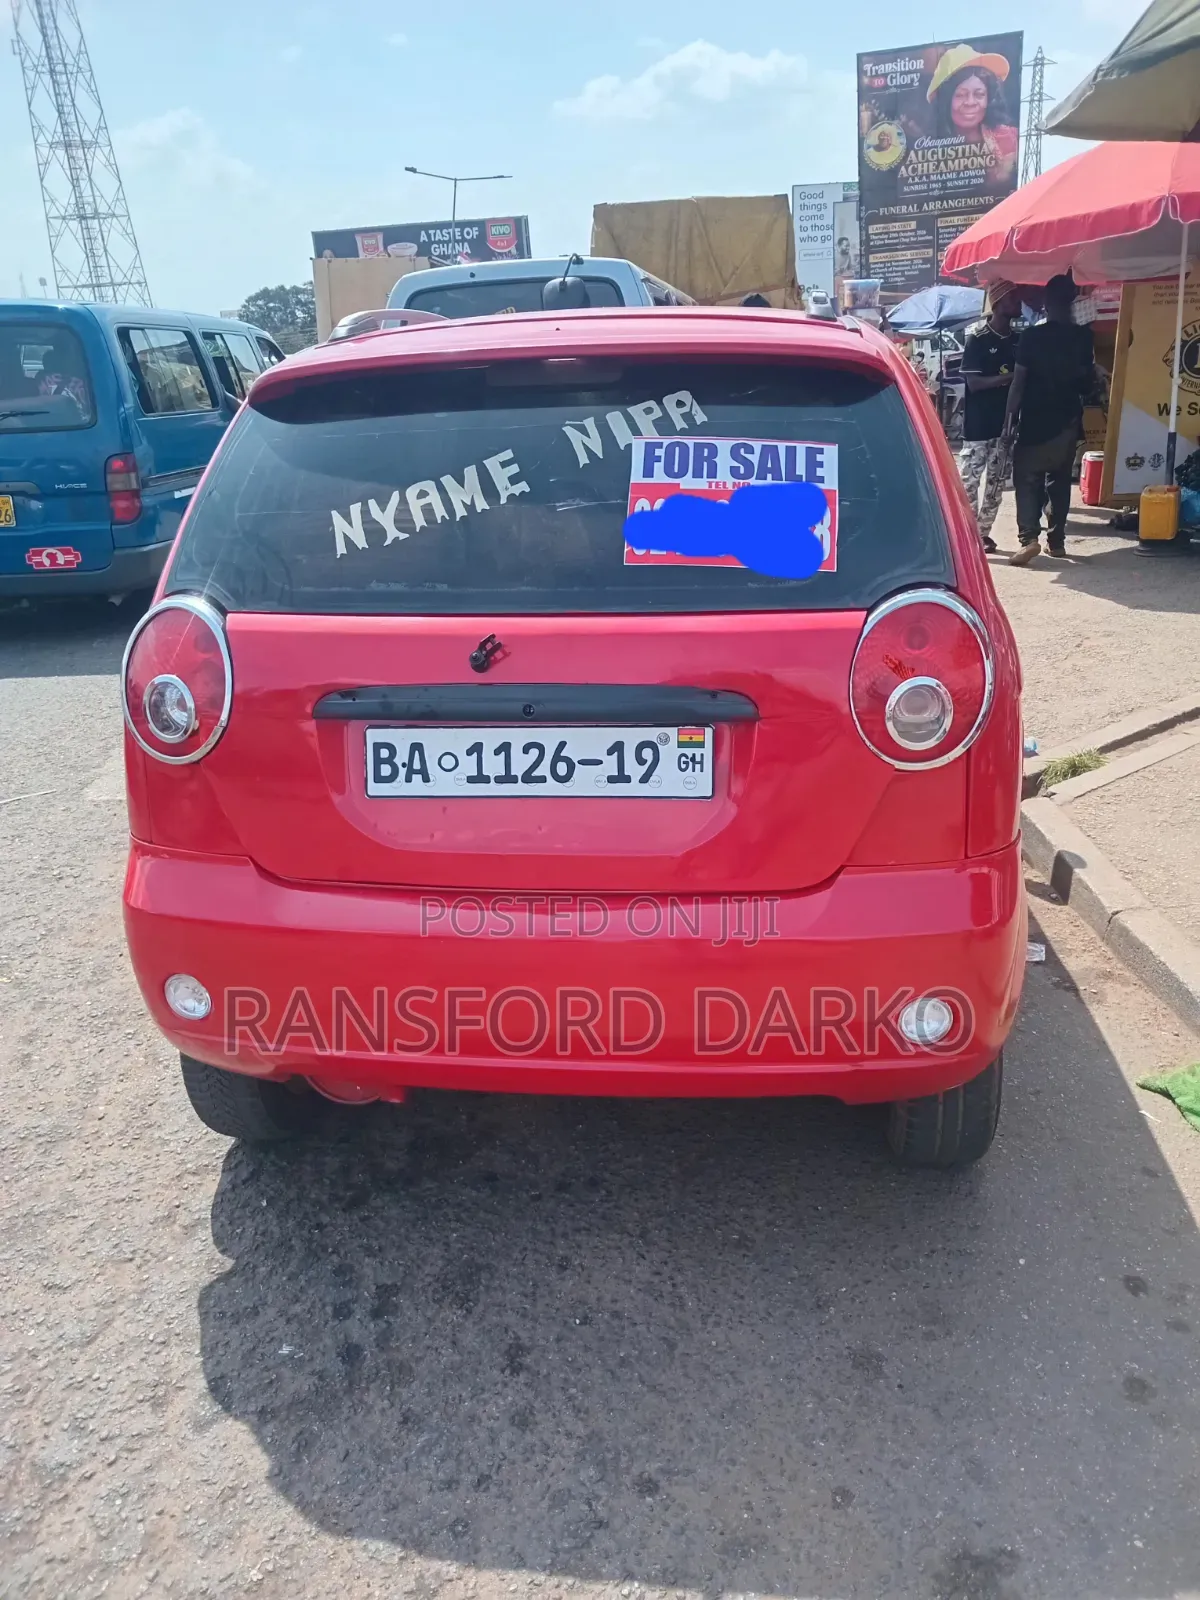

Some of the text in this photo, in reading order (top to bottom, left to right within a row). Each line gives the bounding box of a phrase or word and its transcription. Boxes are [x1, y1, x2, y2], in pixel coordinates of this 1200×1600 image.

[863, 57, 925, 77] Transition
[886, 72, 921, 87] Glory
[905, 143, 990, 165] AUGUSTINA
[897, 154, 996, 179] ACHEAMPONG
[930, 171, 958, 182] MAAME
[958, 168, 986, 178] ADWOA
[903, 182, 929, 192] SUNRISE
[946, 179, 969, 188] SUNSET
[970, 176, 985, 185] 2026
[799, 190, 824, 201] Good
[799, 202, 828, 212] things
[879, 196, 995, 216] FUNERAL ARRANGEMENTS
[799, 212, 825, 222] come
[419, 226, 479, 243] A TASTE OF
[490, 225, 511, 235] KIVO
[799, 222, 834, 233] to those
[871, 224, 891, 232] LAYING
[897, 222, 913, 230] STATE
[799, 234, 832, 244] who go
[430, 241, 472, 256] GHANA
[872, 252, 909, 261] THANKSGIVING
[909, 249, 931, 258] SERVICE
[1183, 323, 1200, 339] LI
[1187, 401, 1200, 416] S
[642, 440, 826, 484] FOR SALE
[330, 448, 531, 559] NYAME
[561, 389, 709, 469] NIPA
[706, 480, 731, 490] TEL
[372, 739, 661, 785] BA 1126-19
[676, 752, 705, 773] GH
